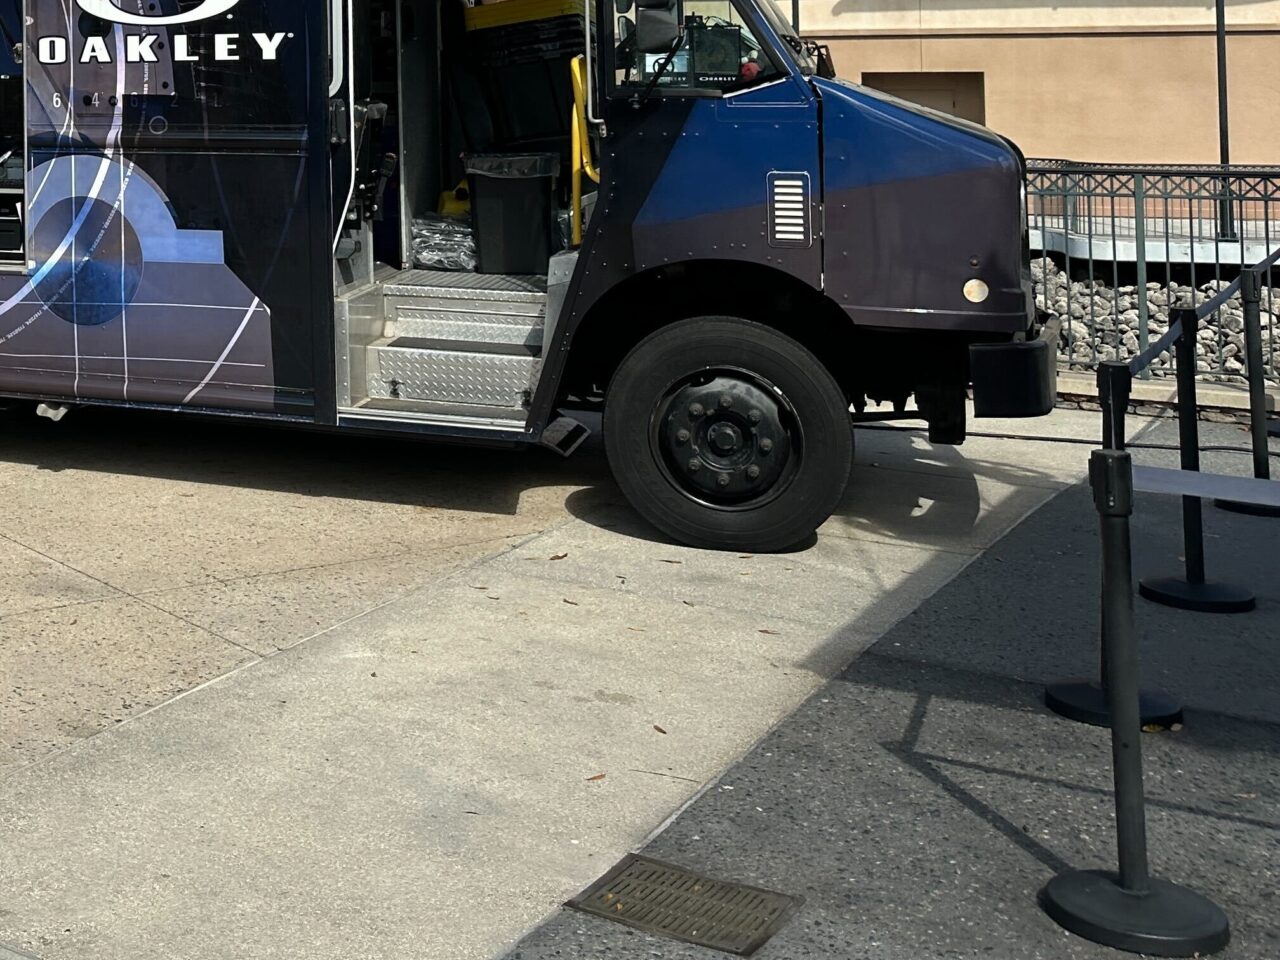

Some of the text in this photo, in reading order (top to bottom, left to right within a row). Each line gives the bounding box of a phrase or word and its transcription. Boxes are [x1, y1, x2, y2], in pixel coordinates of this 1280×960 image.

[37, 32, 288, 65] OAKLEY
[52, 92, 62, 109] 6
[91, 92, 101, 108] 4
